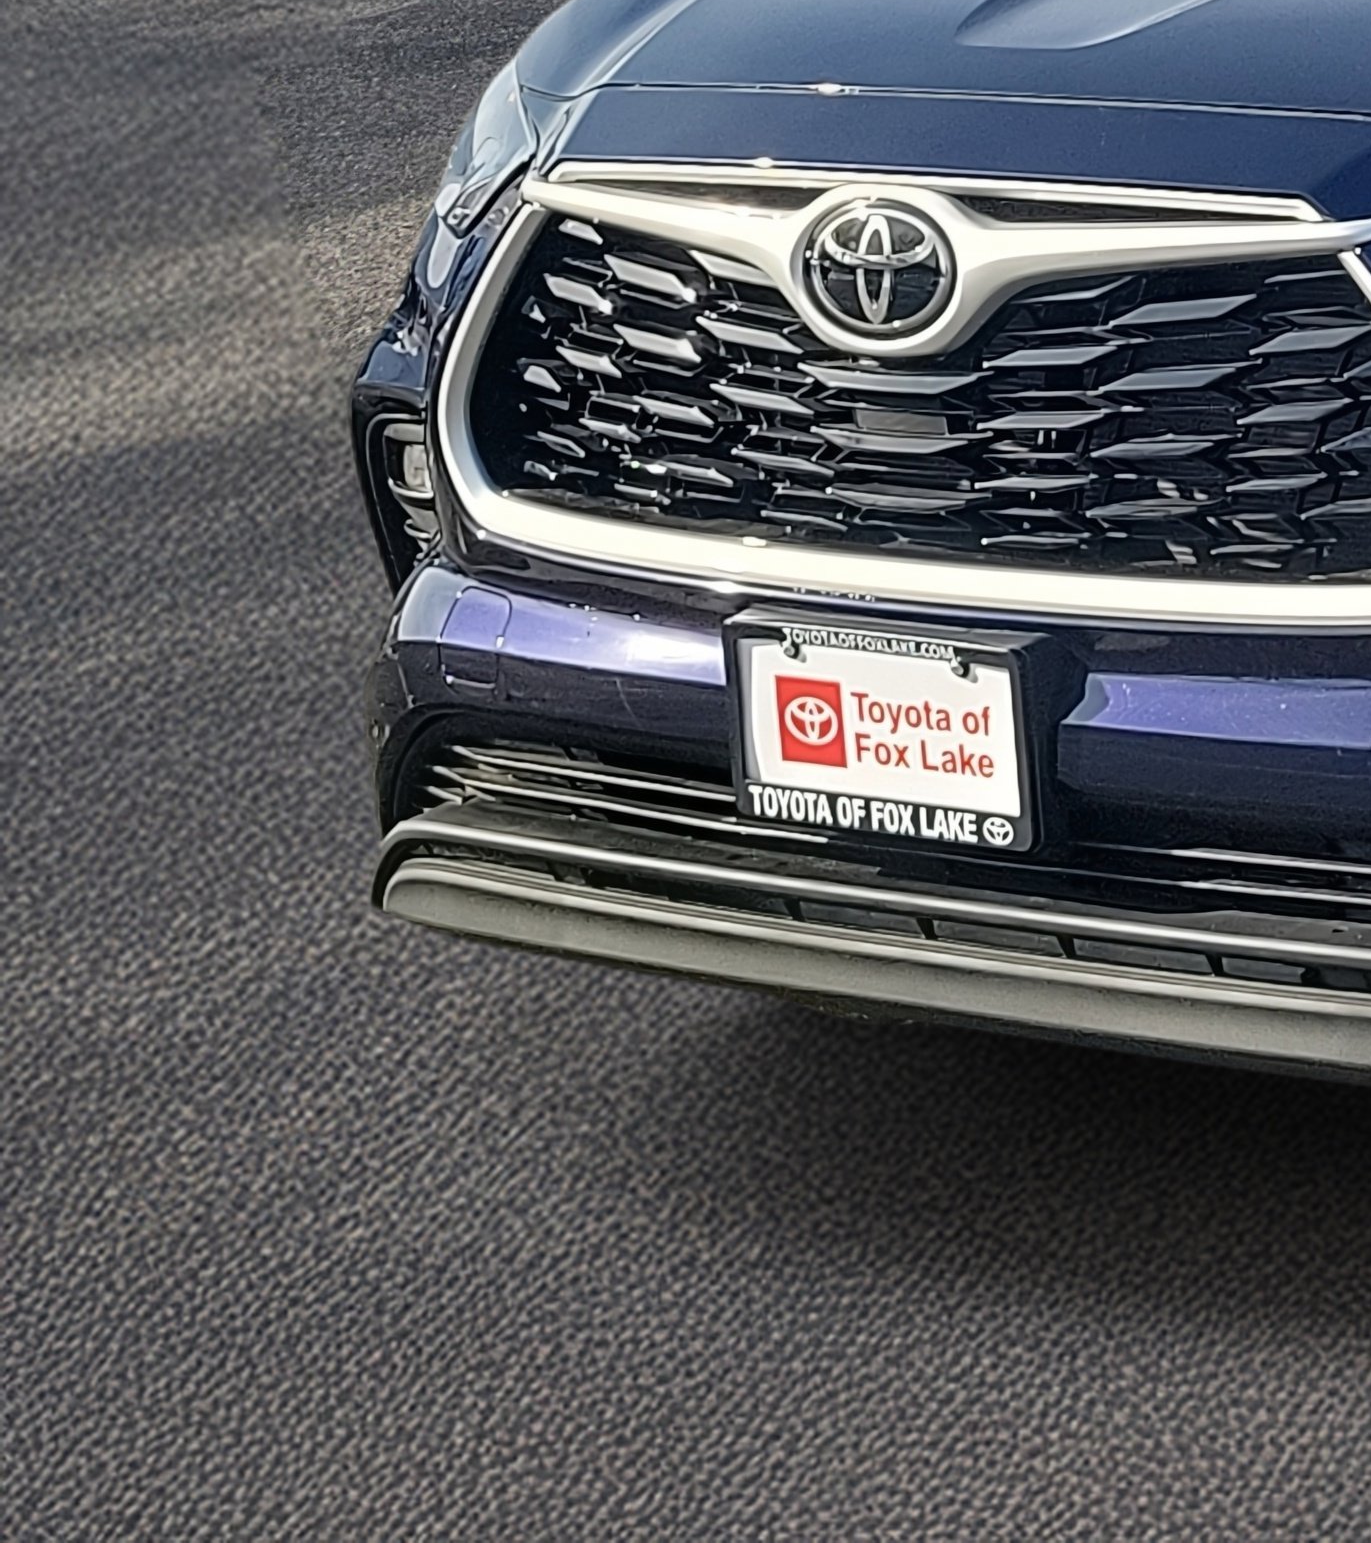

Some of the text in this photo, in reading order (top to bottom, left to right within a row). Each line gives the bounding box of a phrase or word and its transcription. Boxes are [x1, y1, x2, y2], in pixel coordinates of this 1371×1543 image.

[851, 692, 991, 736] Toyota of
[855, 732, 995, 779] Fox Lake
[748, 785, 979, 843] TOYOTA OF FOX LAKE
